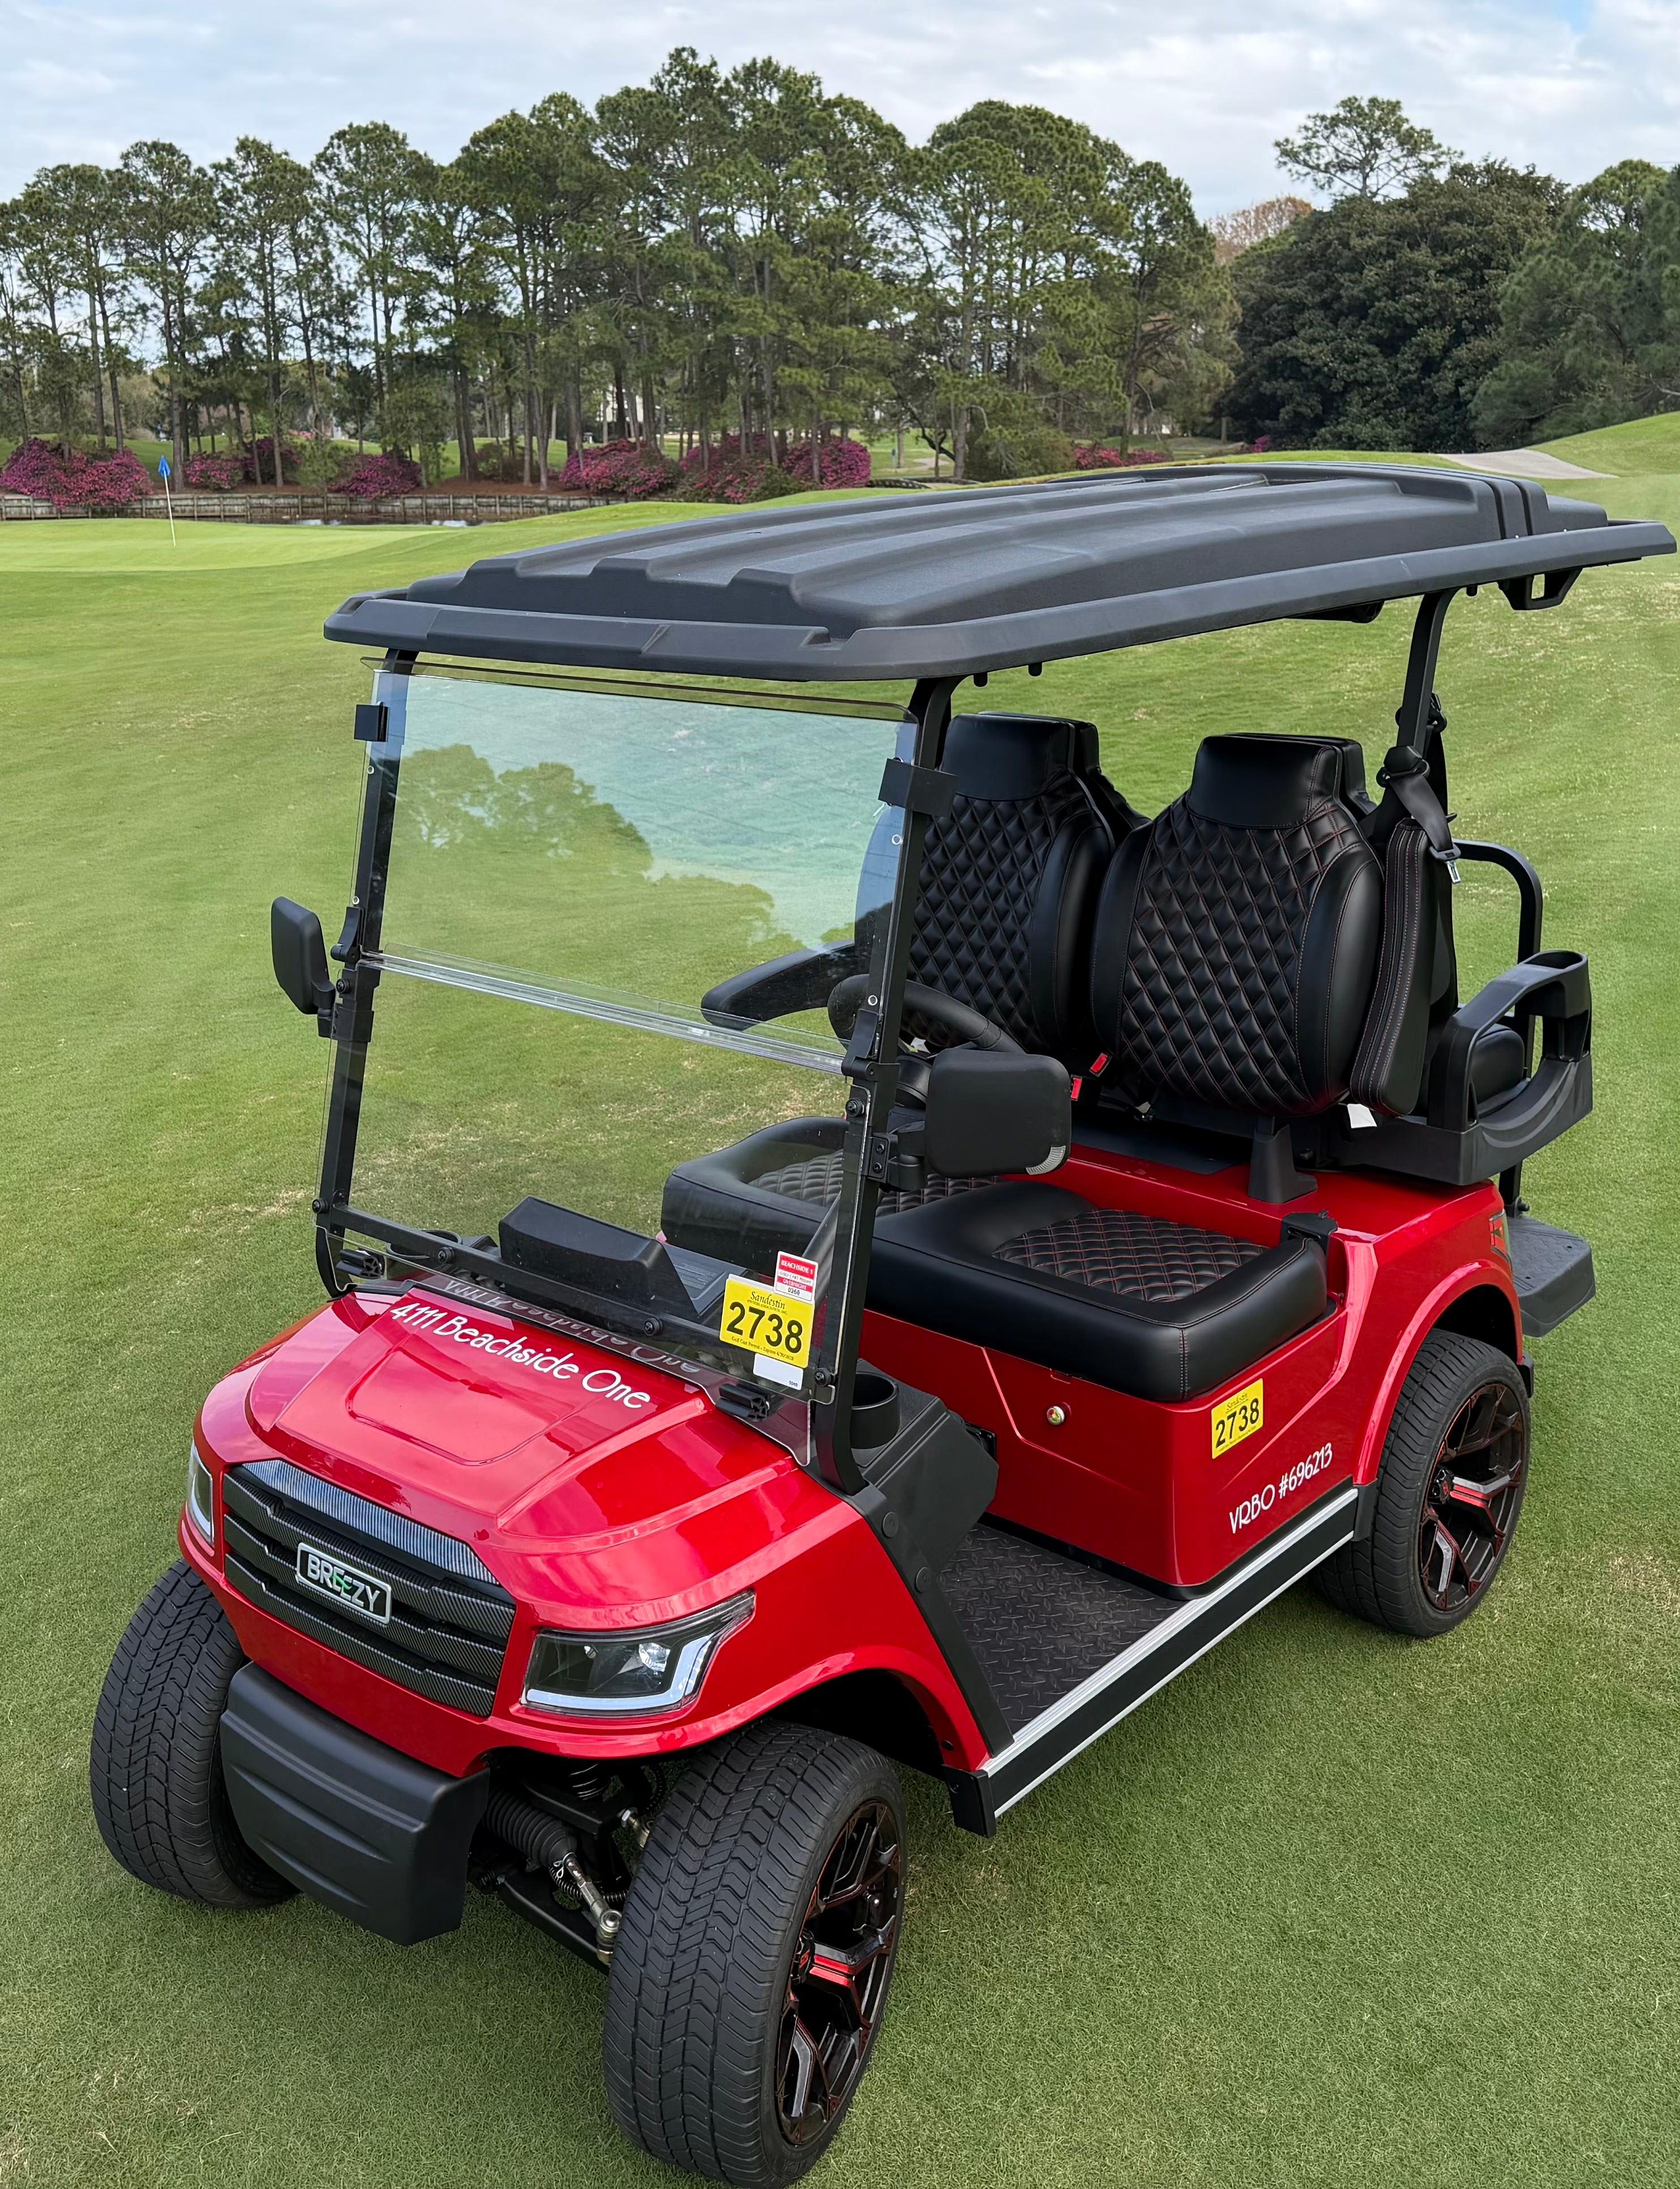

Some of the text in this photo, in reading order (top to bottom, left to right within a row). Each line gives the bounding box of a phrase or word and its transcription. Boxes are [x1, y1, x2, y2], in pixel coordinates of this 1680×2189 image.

[726, 1301, 803, 1354] 2738
[750, 1291, 785, 1309] Sandestin
[391, 1303, 650, 1409] 4111 Beachside One
[1215, 1398, 1259, 1449] 2738
[1229, 1442, 1332, 1533] VRBO #696213
[307, 1554, 380, 1612] BREEZY
